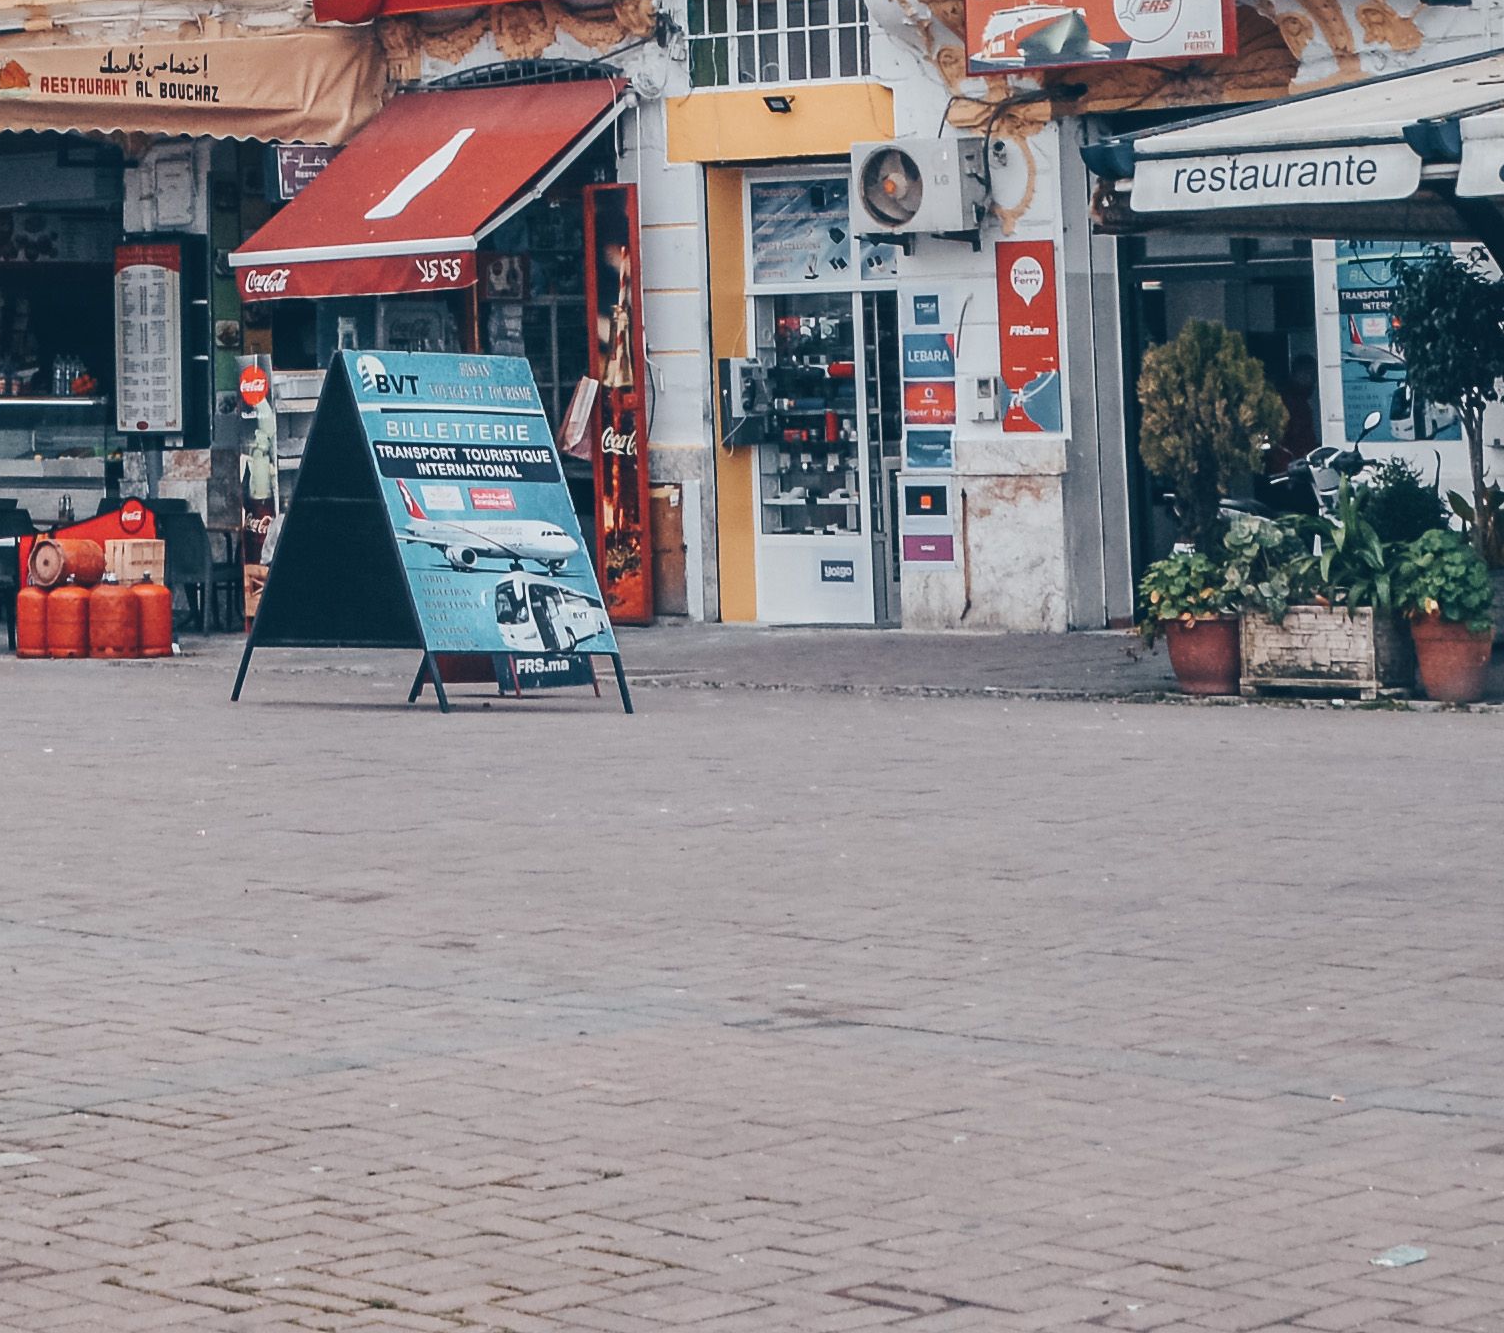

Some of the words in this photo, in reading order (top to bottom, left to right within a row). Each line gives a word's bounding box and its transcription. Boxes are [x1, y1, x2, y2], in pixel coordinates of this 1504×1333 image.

[1187, 30, 1213, 40] FAST
[1184, 40, 1216, 52] FERRY
[40, 76, 128, 96] RESTAURANT
[135, 80, 153, 98] AL
[1172, 154, 1378, 195] restaurante
[245, 269, 291, 293] Coca-Cola
[1014, 276, 1040, 285] Ferry
[1341, 290, 1390, 300] TRANSPORT
[908, 350, 950, 362] LEBARA
[375, 374, 419, 396] BVT
[489, 386, 533, 401] TOURISME
[932, 408, 941, 416] to
[387, 420, 530, 441] BILLETTERIE
[376, 444, 456, 460] TRANSPORT
[462, 448, 552, 463] TOURISTIQUE
[416, 463, 522, 478] INTERNATIONAL
[516, 658, 570, 675] FRS.ma
